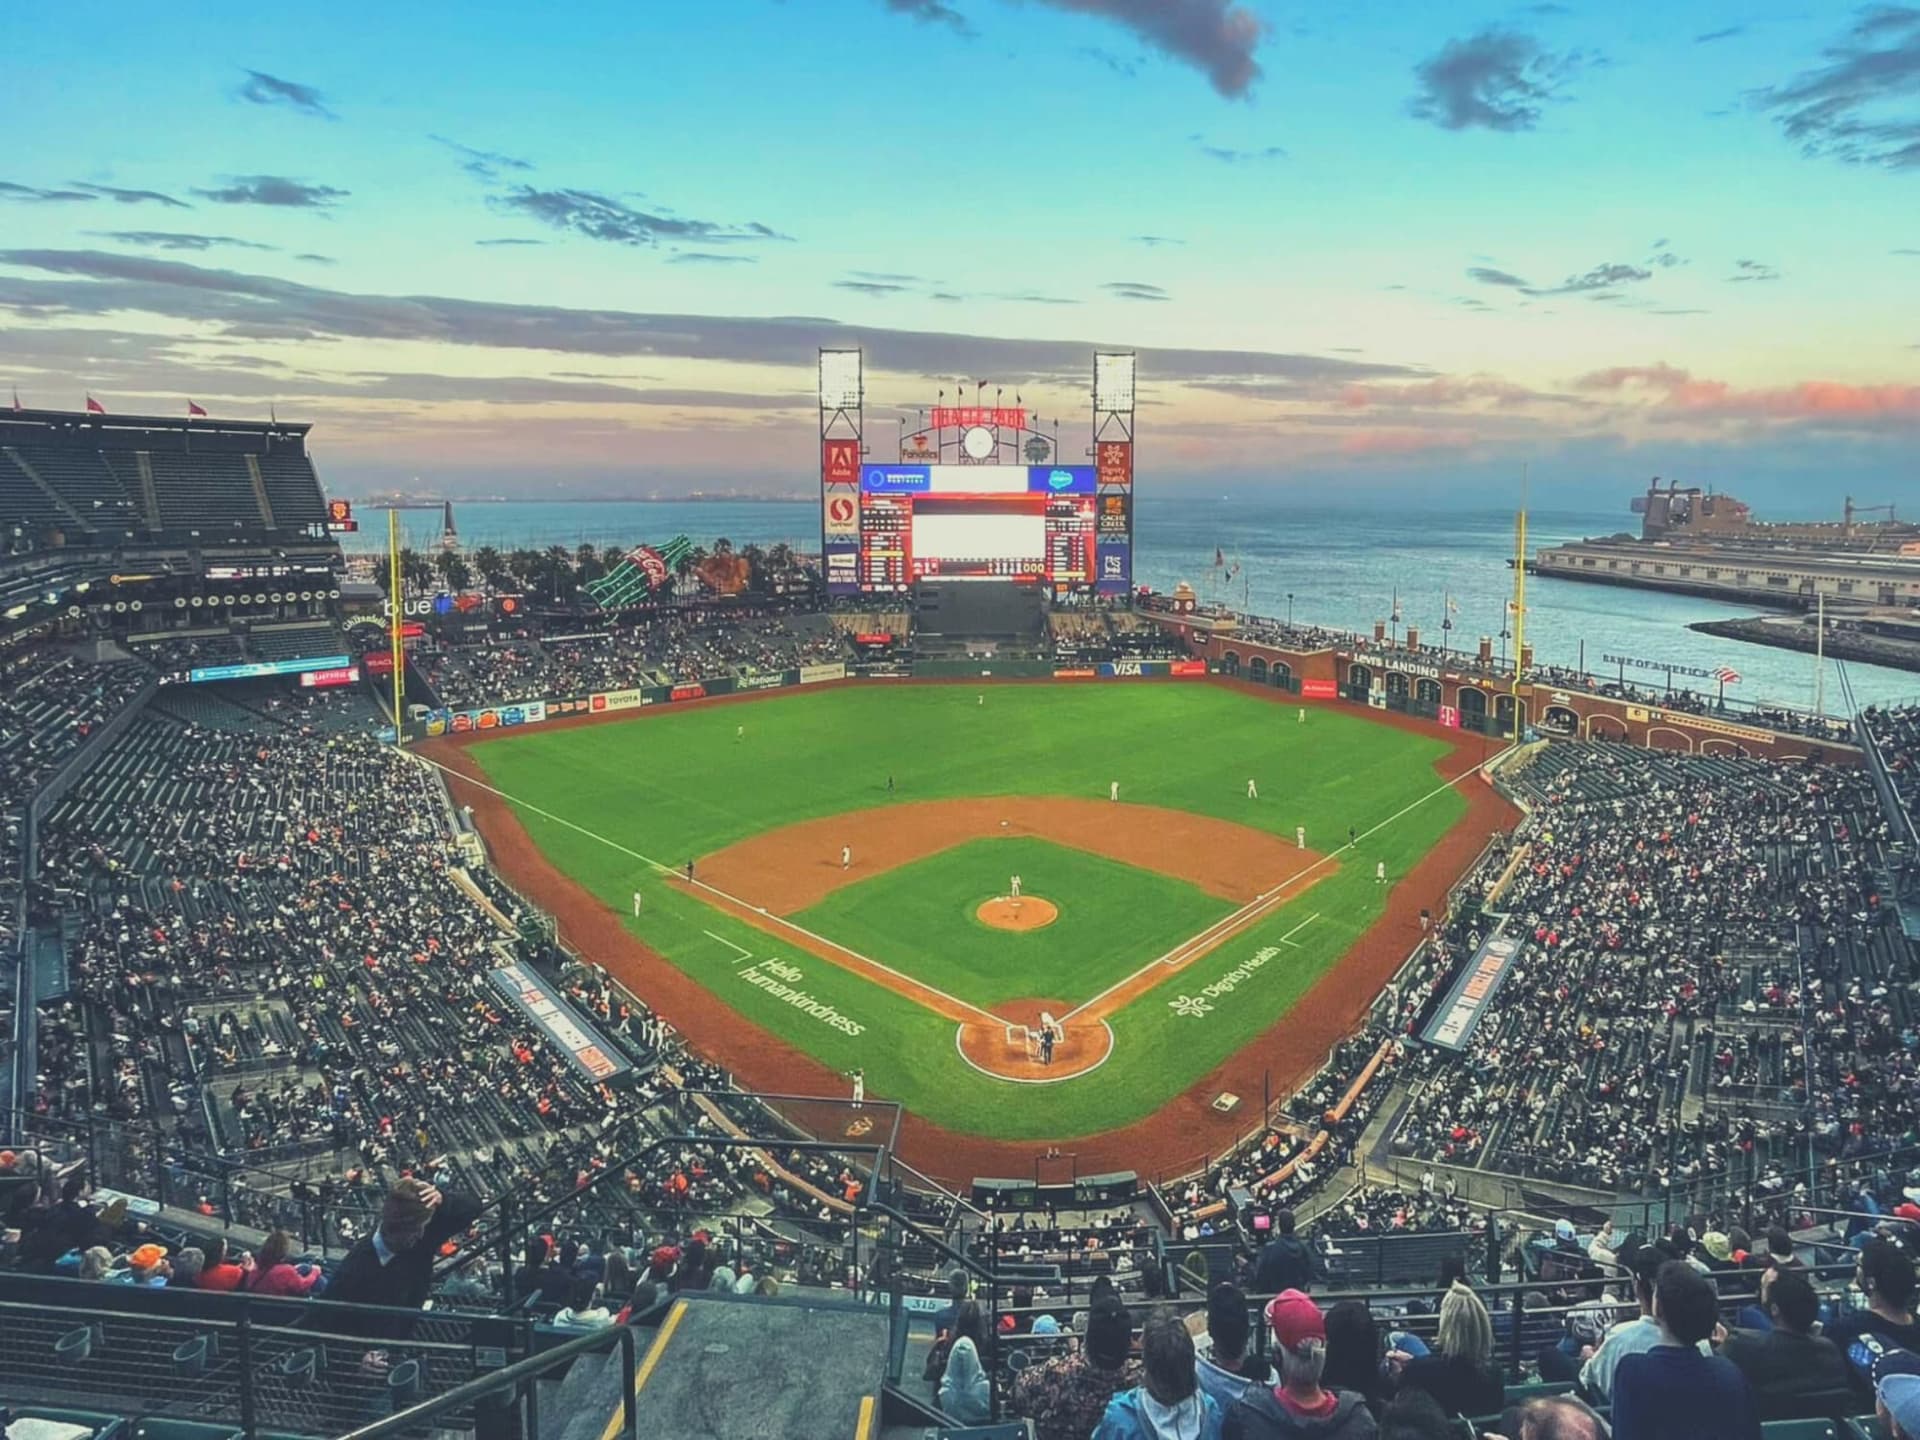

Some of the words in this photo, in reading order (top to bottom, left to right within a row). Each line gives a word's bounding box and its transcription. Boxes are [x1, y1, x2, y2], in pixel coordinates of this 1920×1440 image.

[1112, 663, 1142, 675] VISA
[1385, 658, 1438, 678] LANDING
[608, 695, 638, 705] TOYOTA
[758, 958, 803, 982] Hello
[1201, 968, 1251, 997] Dignity
[1239, 946, 1281, 970] Health
[737, 966, 866, 1036] humankindness
